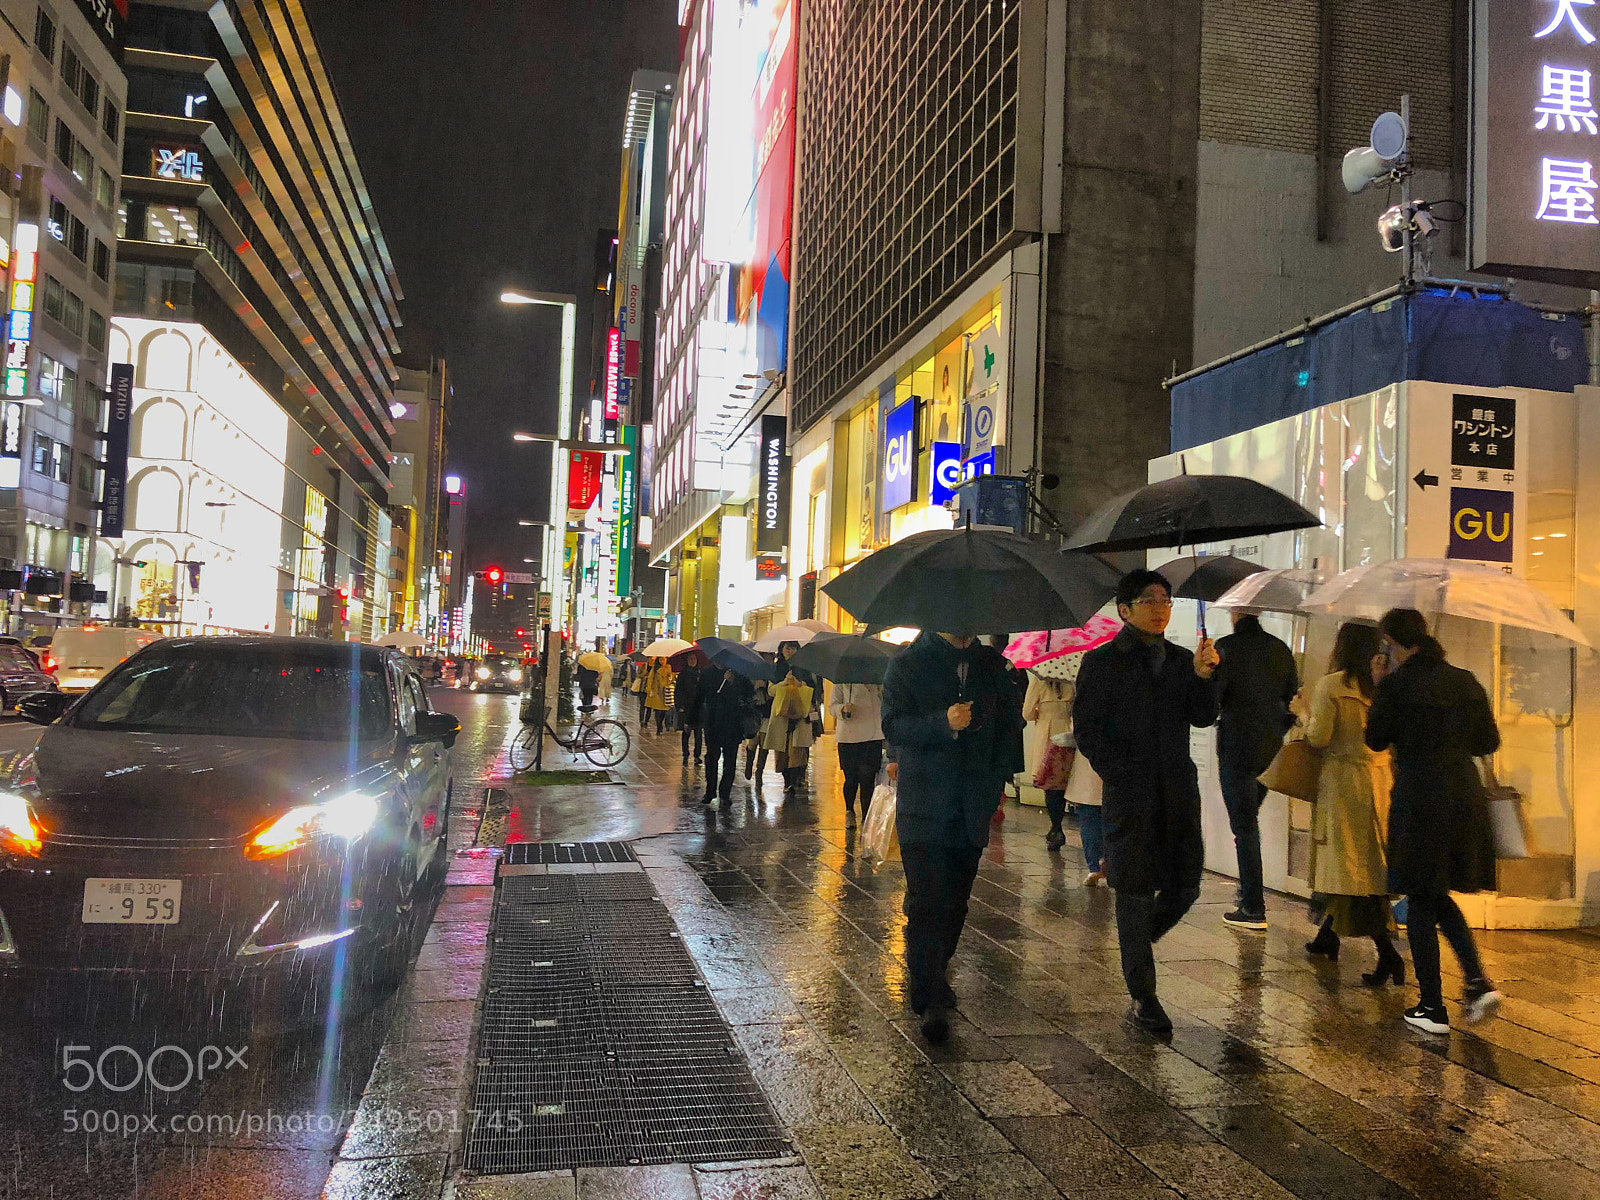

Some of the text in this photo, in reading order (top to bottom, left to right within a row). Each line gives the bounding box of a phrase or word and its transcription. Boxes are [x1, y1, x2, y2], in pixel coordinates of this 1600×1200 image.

[1534, 0, 1599, 225] 大黒屋
[629, 284, 639, 325] docomo
[1471, 408, 1496, 422] 銀座
[1454, 420, 1514, 438] ワシントン
[886, 430, 912, 483] GU
[1468, 441, 1498, 456] 本店
[766, 438, 780, 530] WASHINGTON
[1450, 467, 1515, 484] 営業中
[1453, 507, 1510, 543] GU
[137, 883, 161, 895] 330
[89, 904, 101, 913] に
